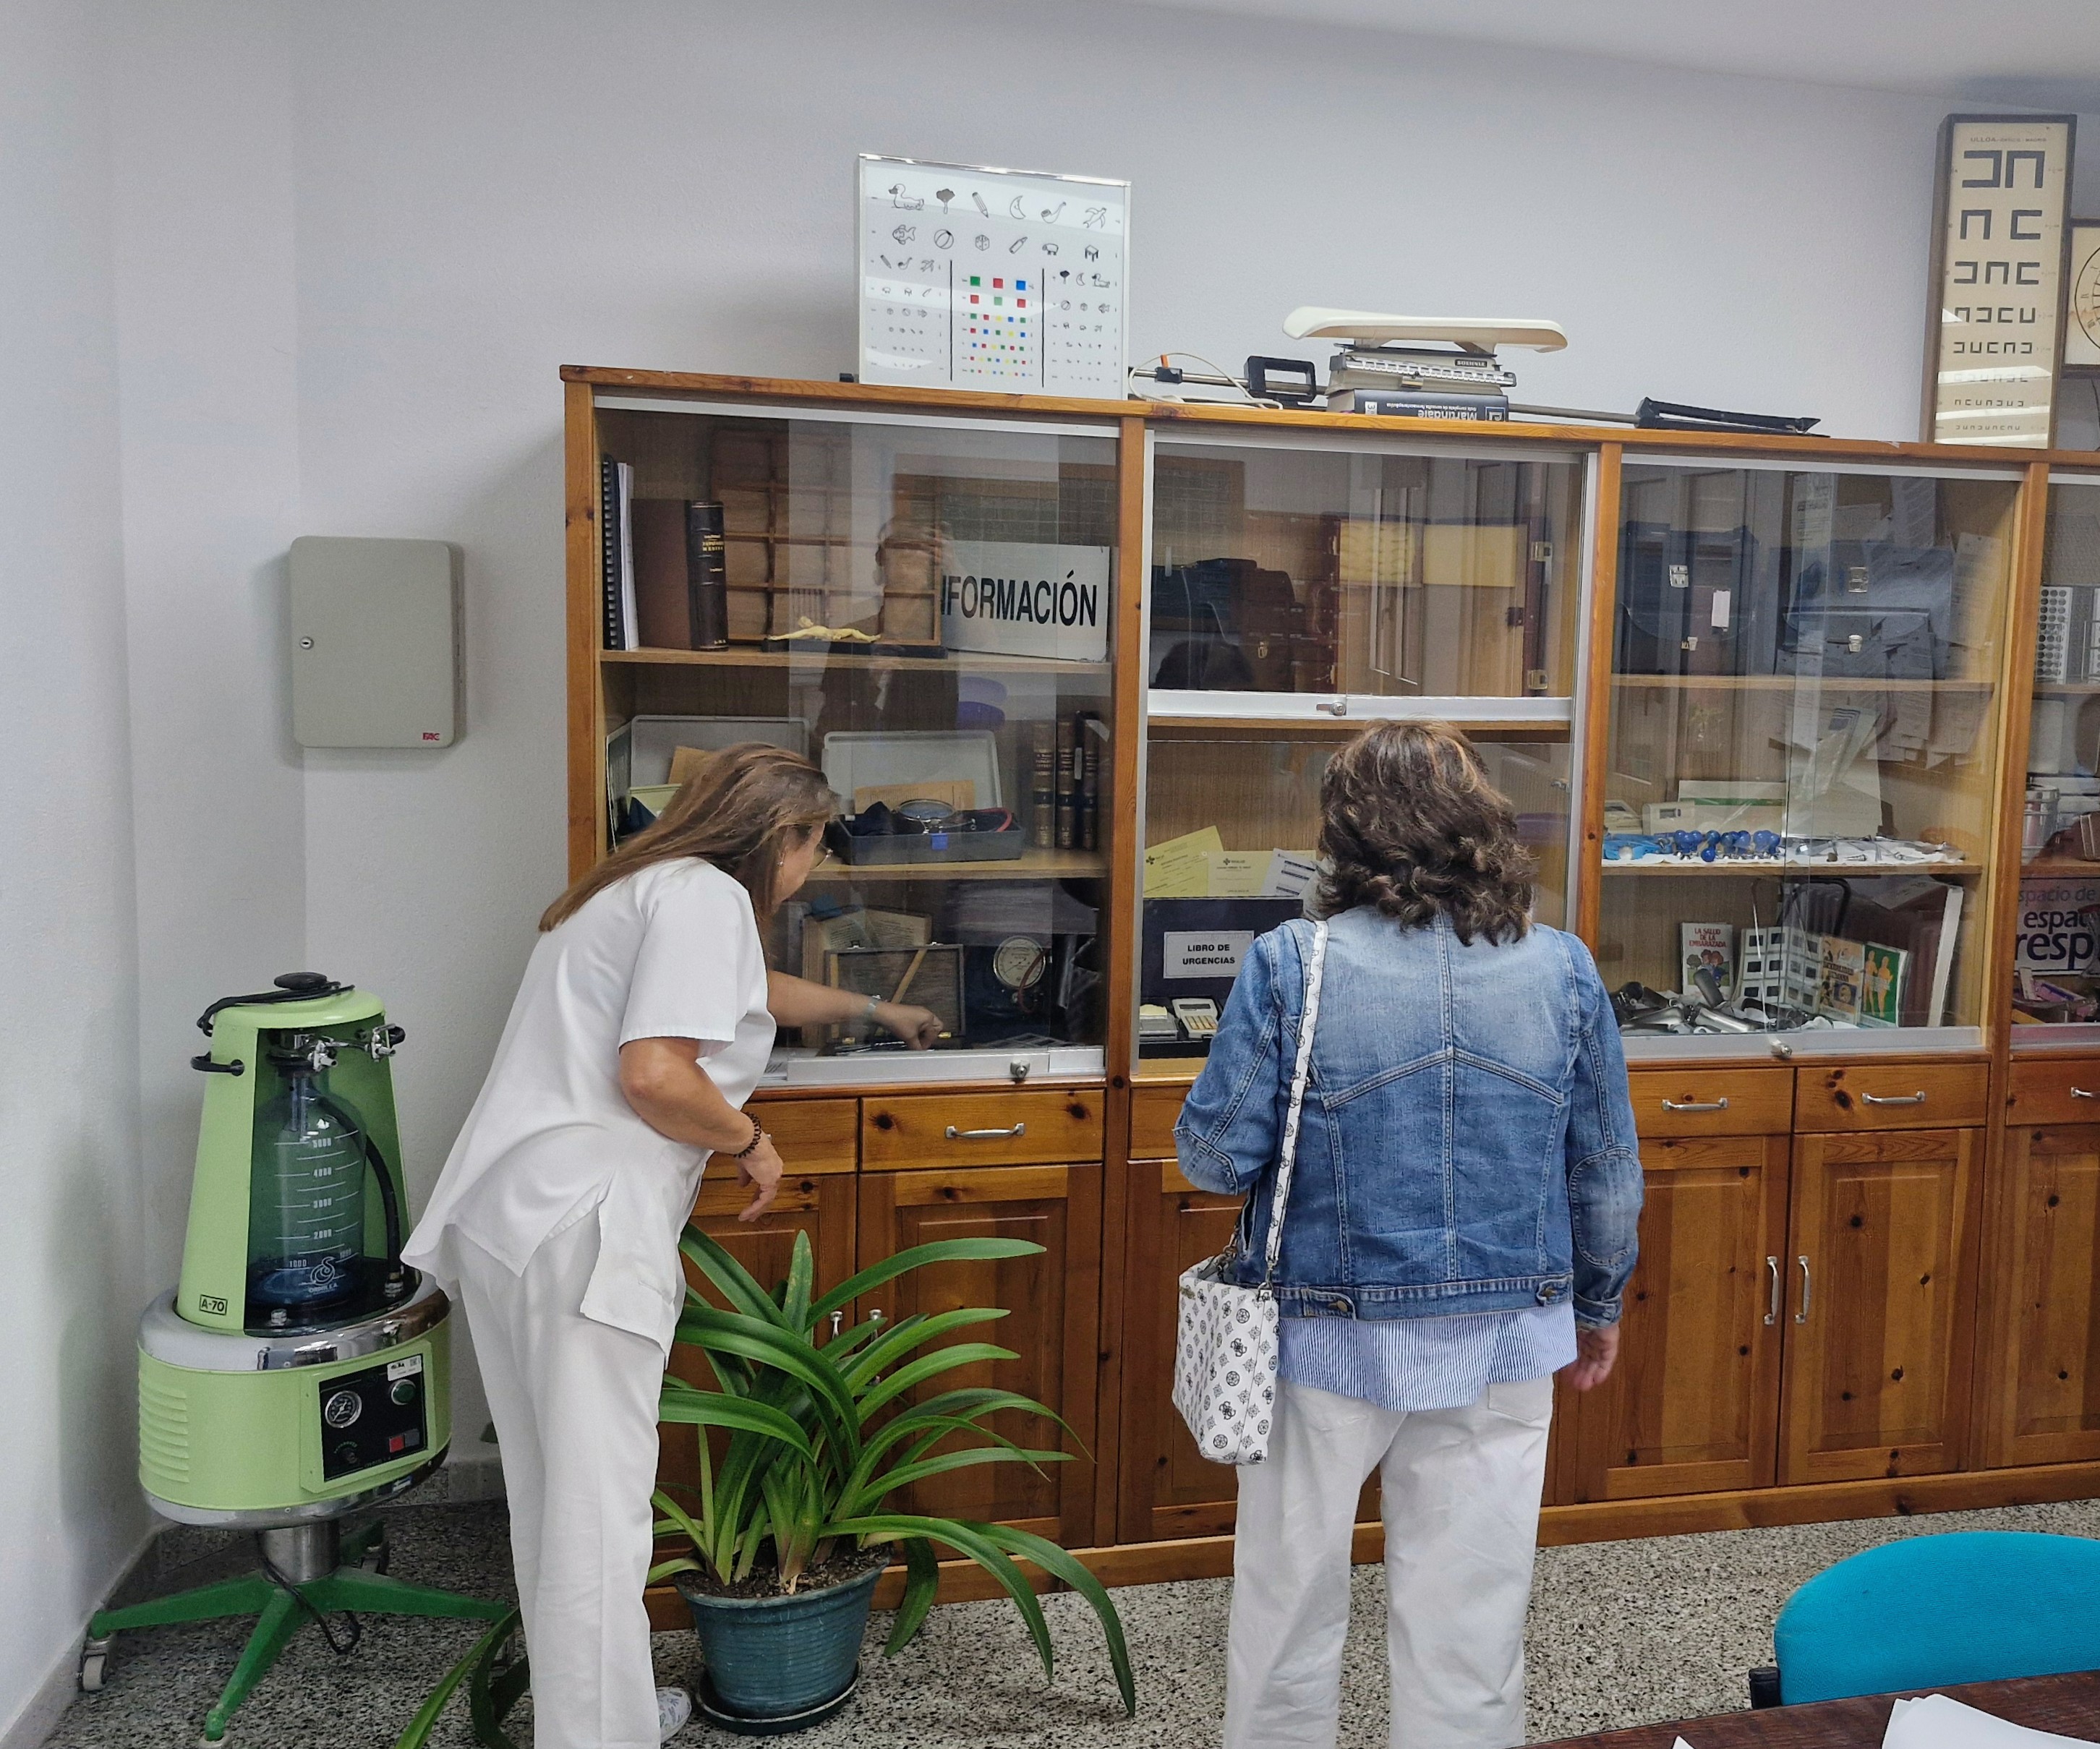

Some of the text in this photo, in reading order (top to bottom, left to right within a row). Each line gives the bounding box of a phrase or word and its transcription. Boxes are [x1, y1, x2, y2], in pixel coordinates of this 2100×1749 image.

[2023, 910, 2088, 935] espac
[2015, 932, 2100, 970] resp
[1182, 957, 1235, 965] URGENCIAS
[312, 1137, 332, 1148] 5000
[313, 1166, 332, 1178] 4000
[313, 1197, 332, 1209] 3000
[313, 1228, 332, 1240] 2000
[289, 1259, 307, 1268] 1000
[201, 1298, 225, 1312] A-70
